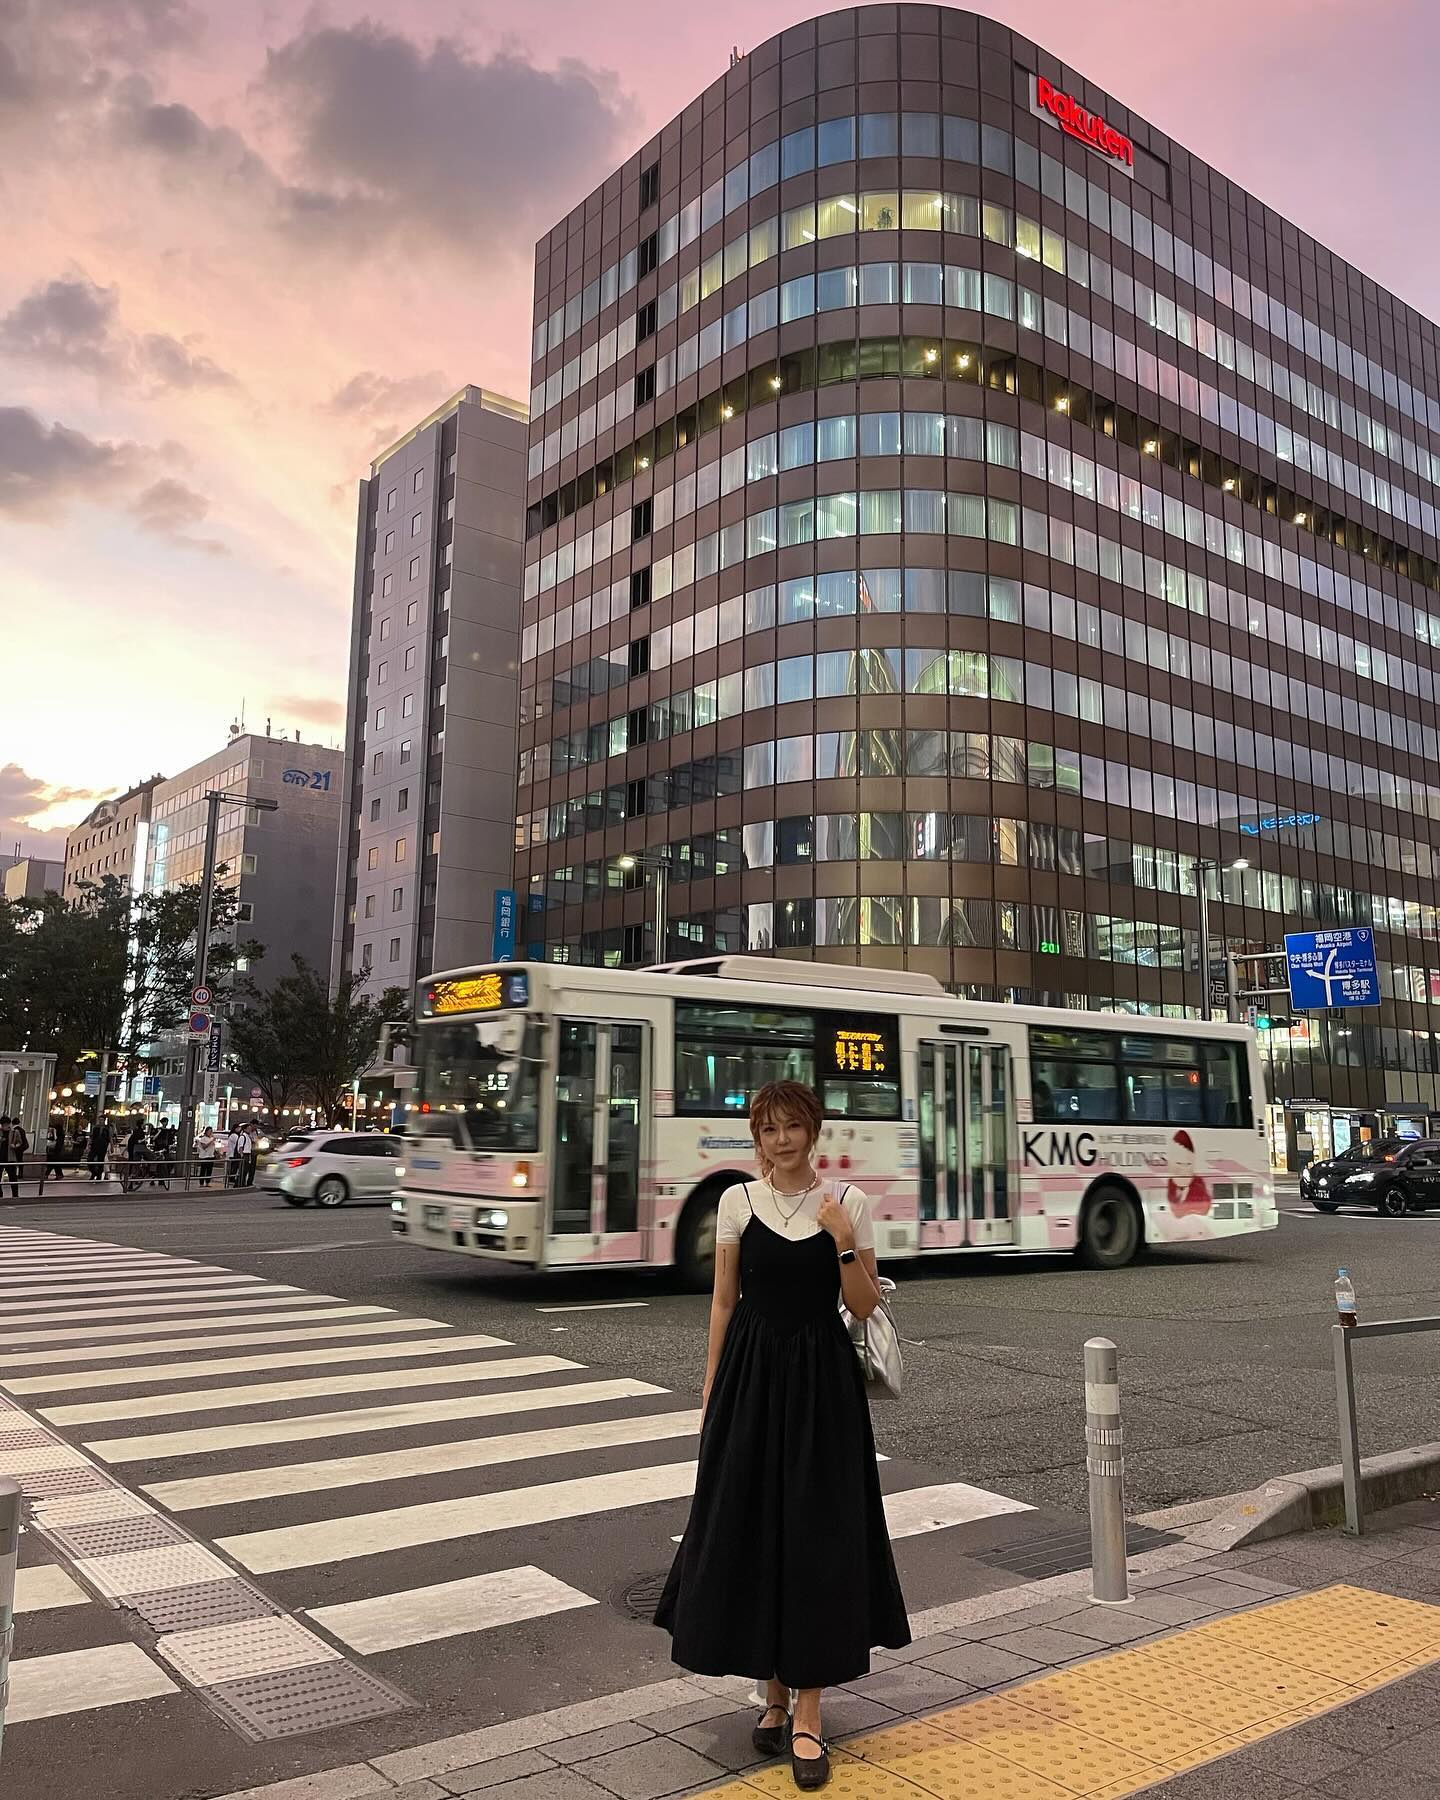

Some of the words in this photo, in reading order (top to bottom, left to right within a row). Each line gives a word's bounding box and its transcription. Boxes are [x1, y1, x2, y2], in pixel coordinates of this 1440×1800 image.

[1038, 75, 1133, 166] Rakuten
[282, 770, 309, 786] City
[310, 771, 331, 790] 21
[500, 896, 511, 937] 福岡銀行
[1315, 931, 1352, 943] 福岡空港
[1342, 980, 1370, 990] 博多駅
[196, 992, 208, 1000] 40
[1022, 1131, 1097, 1166] KMG
